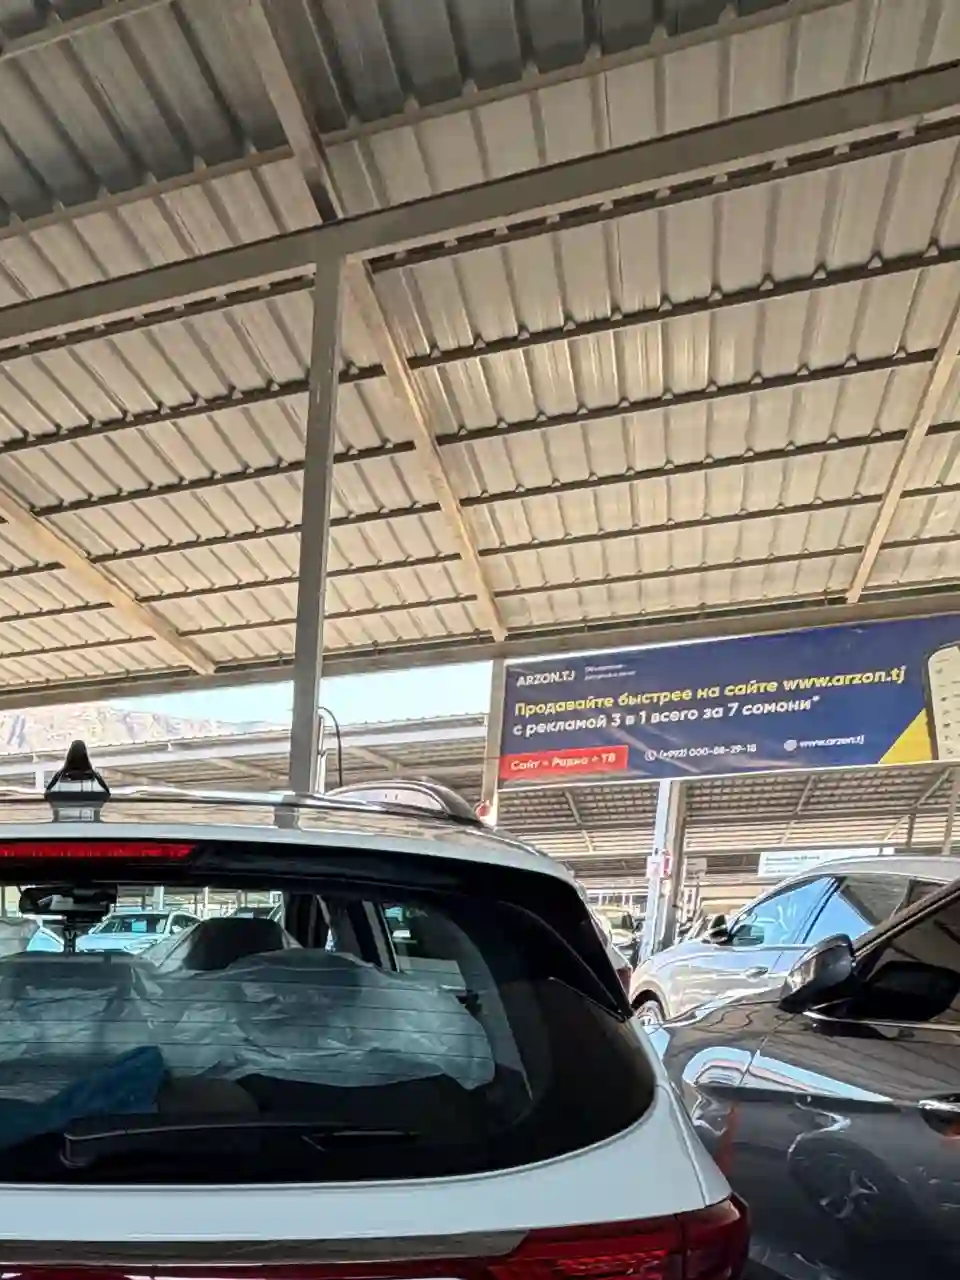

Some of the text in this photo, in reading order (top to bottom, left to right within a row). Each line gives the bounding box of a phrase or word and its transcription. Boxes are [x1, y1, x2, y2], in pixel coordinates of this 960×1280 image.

[514, 665, 907, 718] Продавайте быстрее на сайте www.arzon.tj
[516, 670, 576, 687] ARZON.TJ
[513, 724, 523, 736] с
[525, 712, 608, 738] рекламой
[611, 712, 622, 727] 3
[625, 714, 636, 726] в
[639, 710, 647, 725] 1
[650, 708, 699, 724] всего
[702, 706, 724, 721] за
[727, 702, 740, 717] 7
